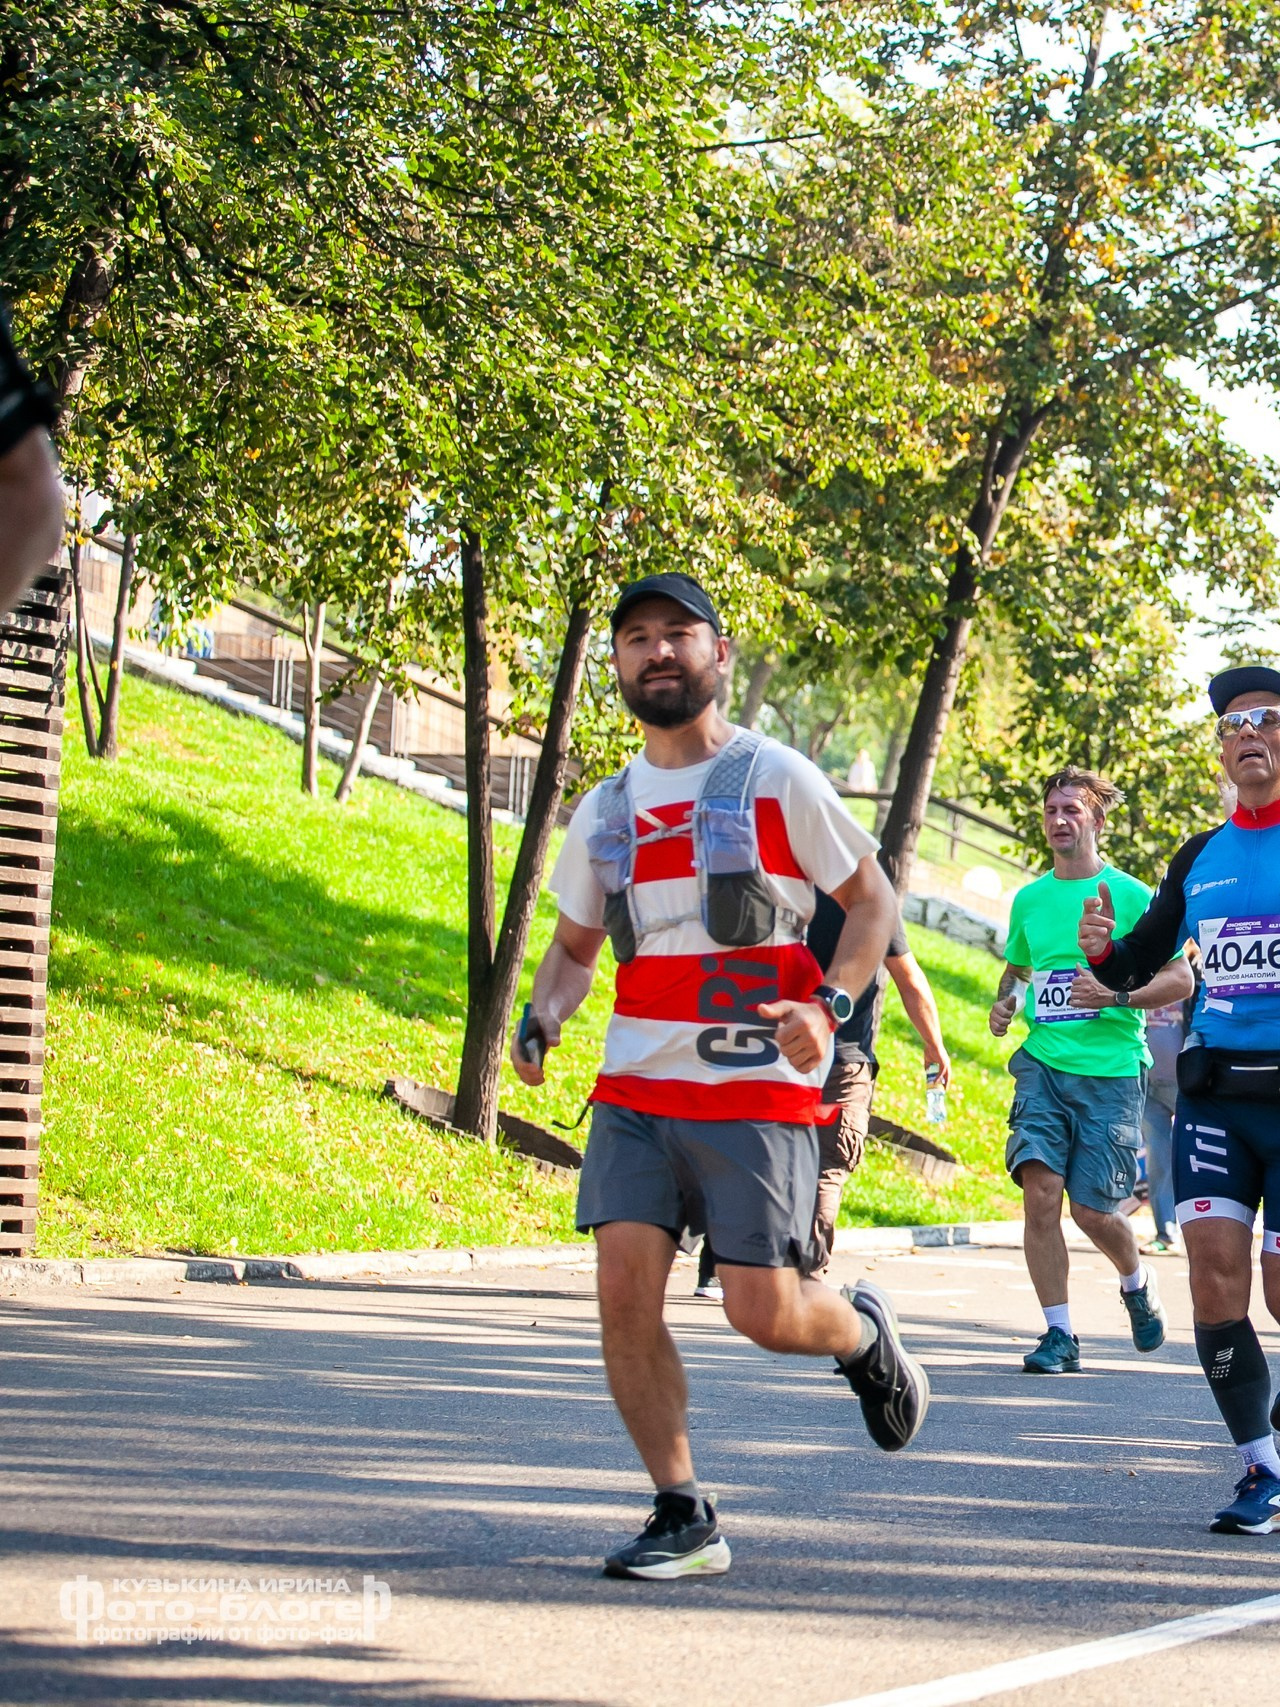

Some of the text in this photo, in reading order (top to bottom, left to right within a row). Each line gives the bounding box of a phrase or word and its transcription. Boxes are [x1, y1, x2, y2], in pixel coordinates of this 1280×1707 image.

[1240, 971, 1276, 979] АНАТОЛИЙ
[1038, 985, 1073, 1008] 40
[1185, 1123, 1229, 1175] Tri
